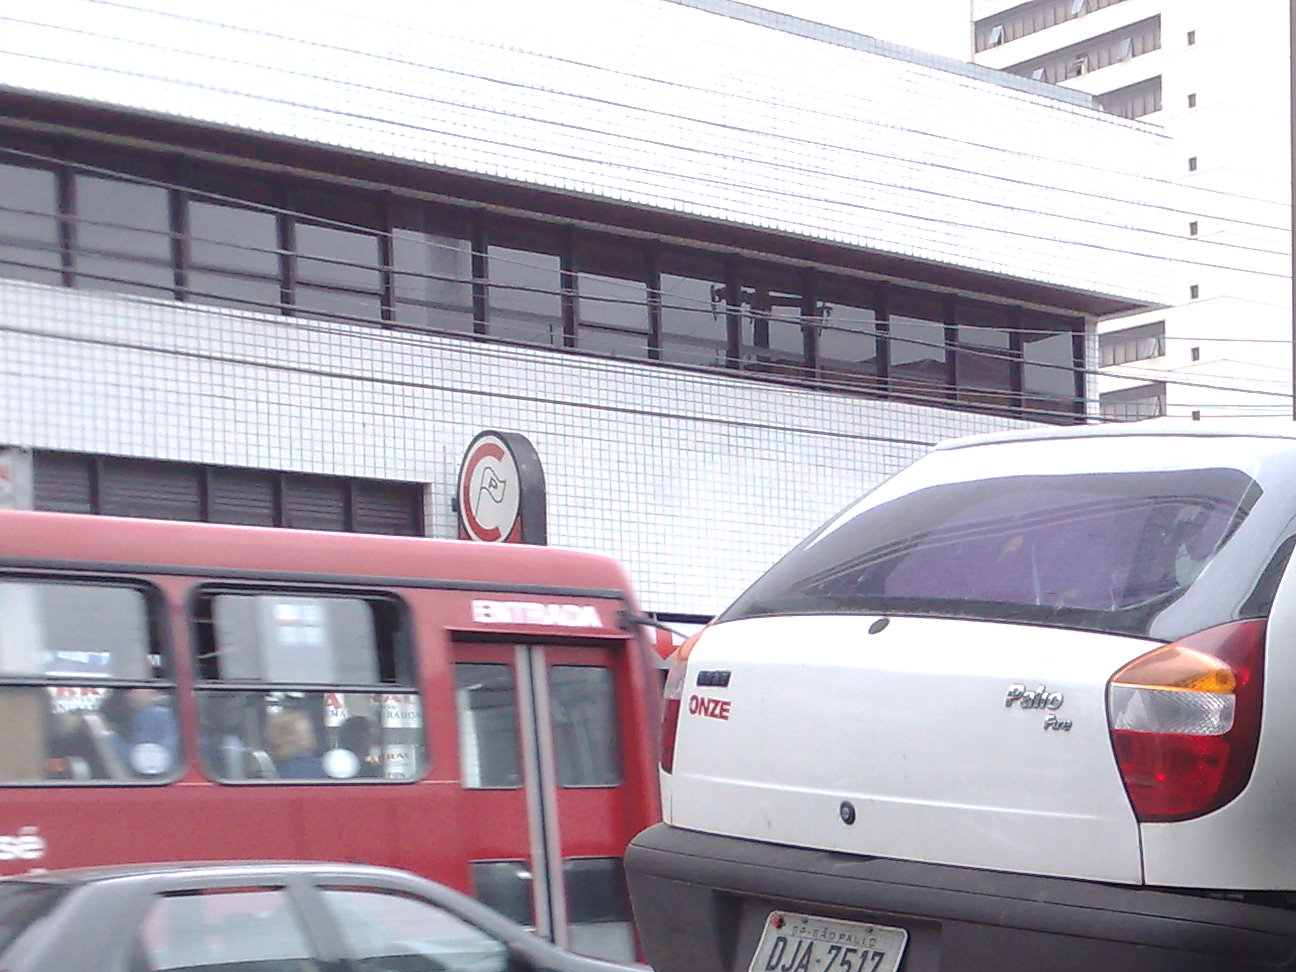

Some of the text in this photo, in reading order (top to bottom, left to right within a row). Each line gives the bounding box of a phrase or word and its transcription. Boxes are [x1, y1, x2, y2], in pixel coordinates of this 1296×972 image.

[689, 694, 731, 720] ONZE
[1005, 683, 1064, 710] Palio
[1043, 714, 1073, 731] Fire
